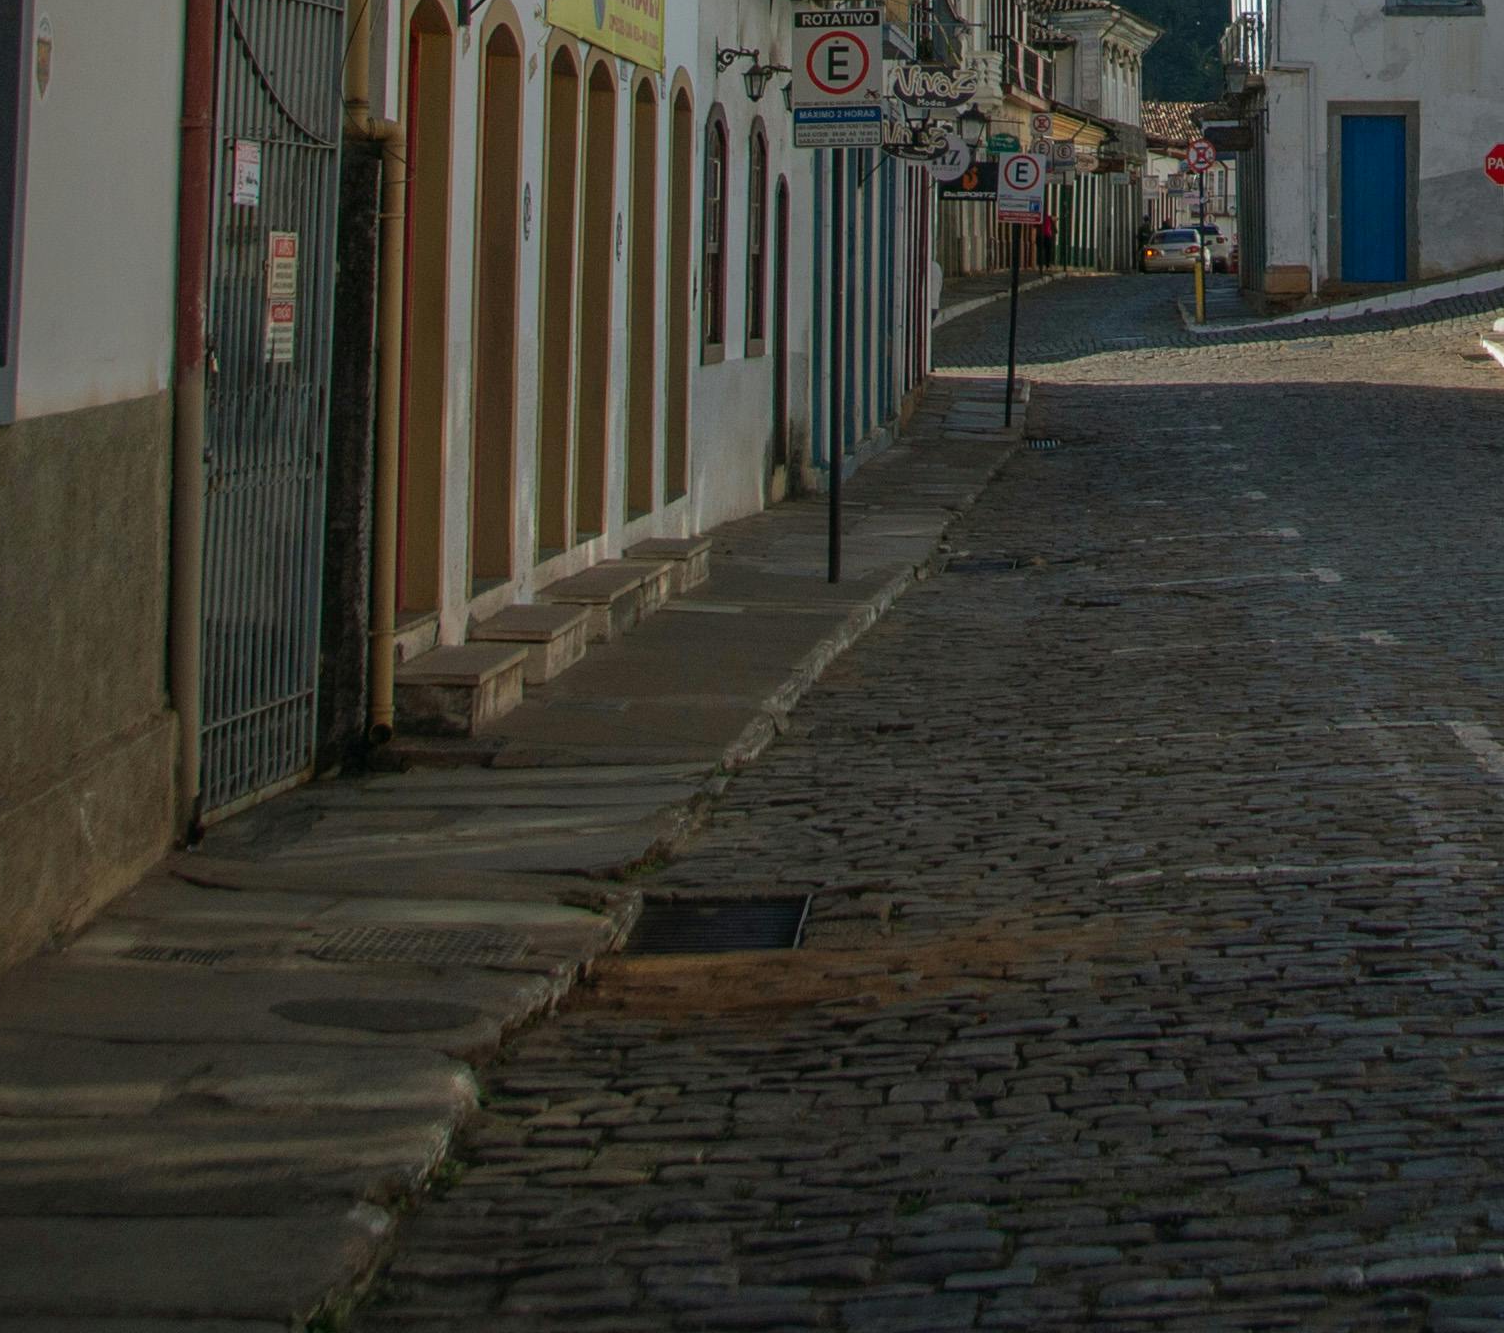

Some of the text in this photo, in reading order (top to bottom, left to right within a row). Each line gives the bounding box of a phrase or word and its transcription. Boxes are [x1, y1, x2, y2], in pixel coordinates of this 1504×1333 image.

[801, 12, 874, 26] ROTATIVO
[828, 46, 849, 81] E
[916, 98, 947, 107] Modas
[844, 108, 876, 118] HORAS
[1015, 162, 1029, 183] E
